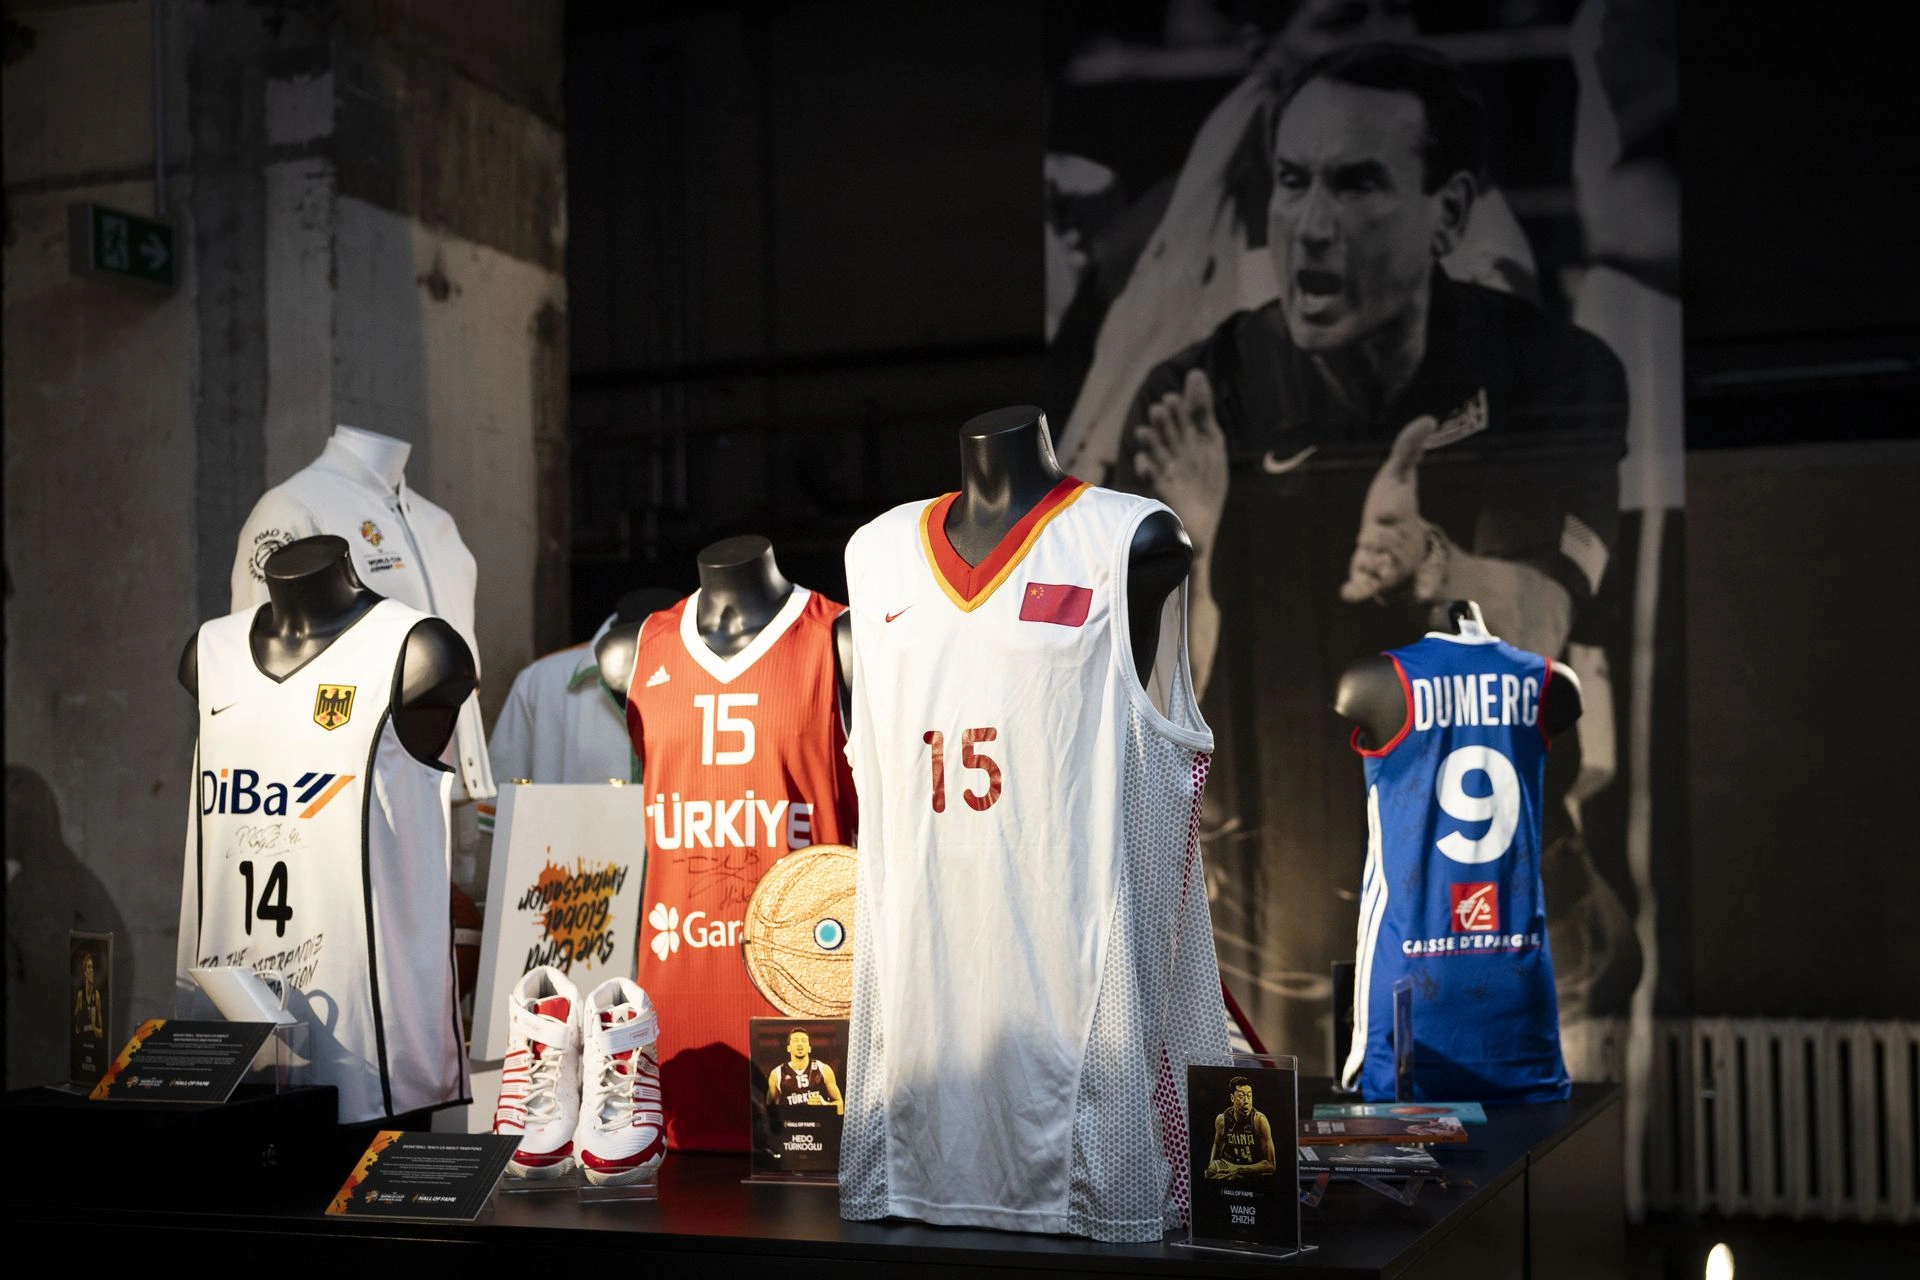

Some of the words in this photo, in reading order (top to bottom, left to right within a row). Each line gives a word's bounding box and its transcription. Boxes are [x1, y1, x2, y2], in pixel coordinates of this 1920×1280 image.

[1412, 673, 1539, 731] DUMERC
[693, 693, 758, 766] 15
[202, 768, 288, 816] DiBa
[923, 727, 1002, 813] 15
[646, 790, 814, 850] ÜRKİYE
[1435, 745, 1521, 864] 9
[239, 861, 293, 938] 14
[517, 864, 629, 912] Ambassador
[543, 897, 609, 943] Global
[682, 911, 745, 948] Gar
[1402, 937, 1455, 955] CAISSE
[796, 1074, 810, 1088] 15
[792, 1134, 813, 1143] HEDO
[1230, 1205, 1256, 1215] WANG
[1231, 1214, 1255, 1225] ZHIZHI
